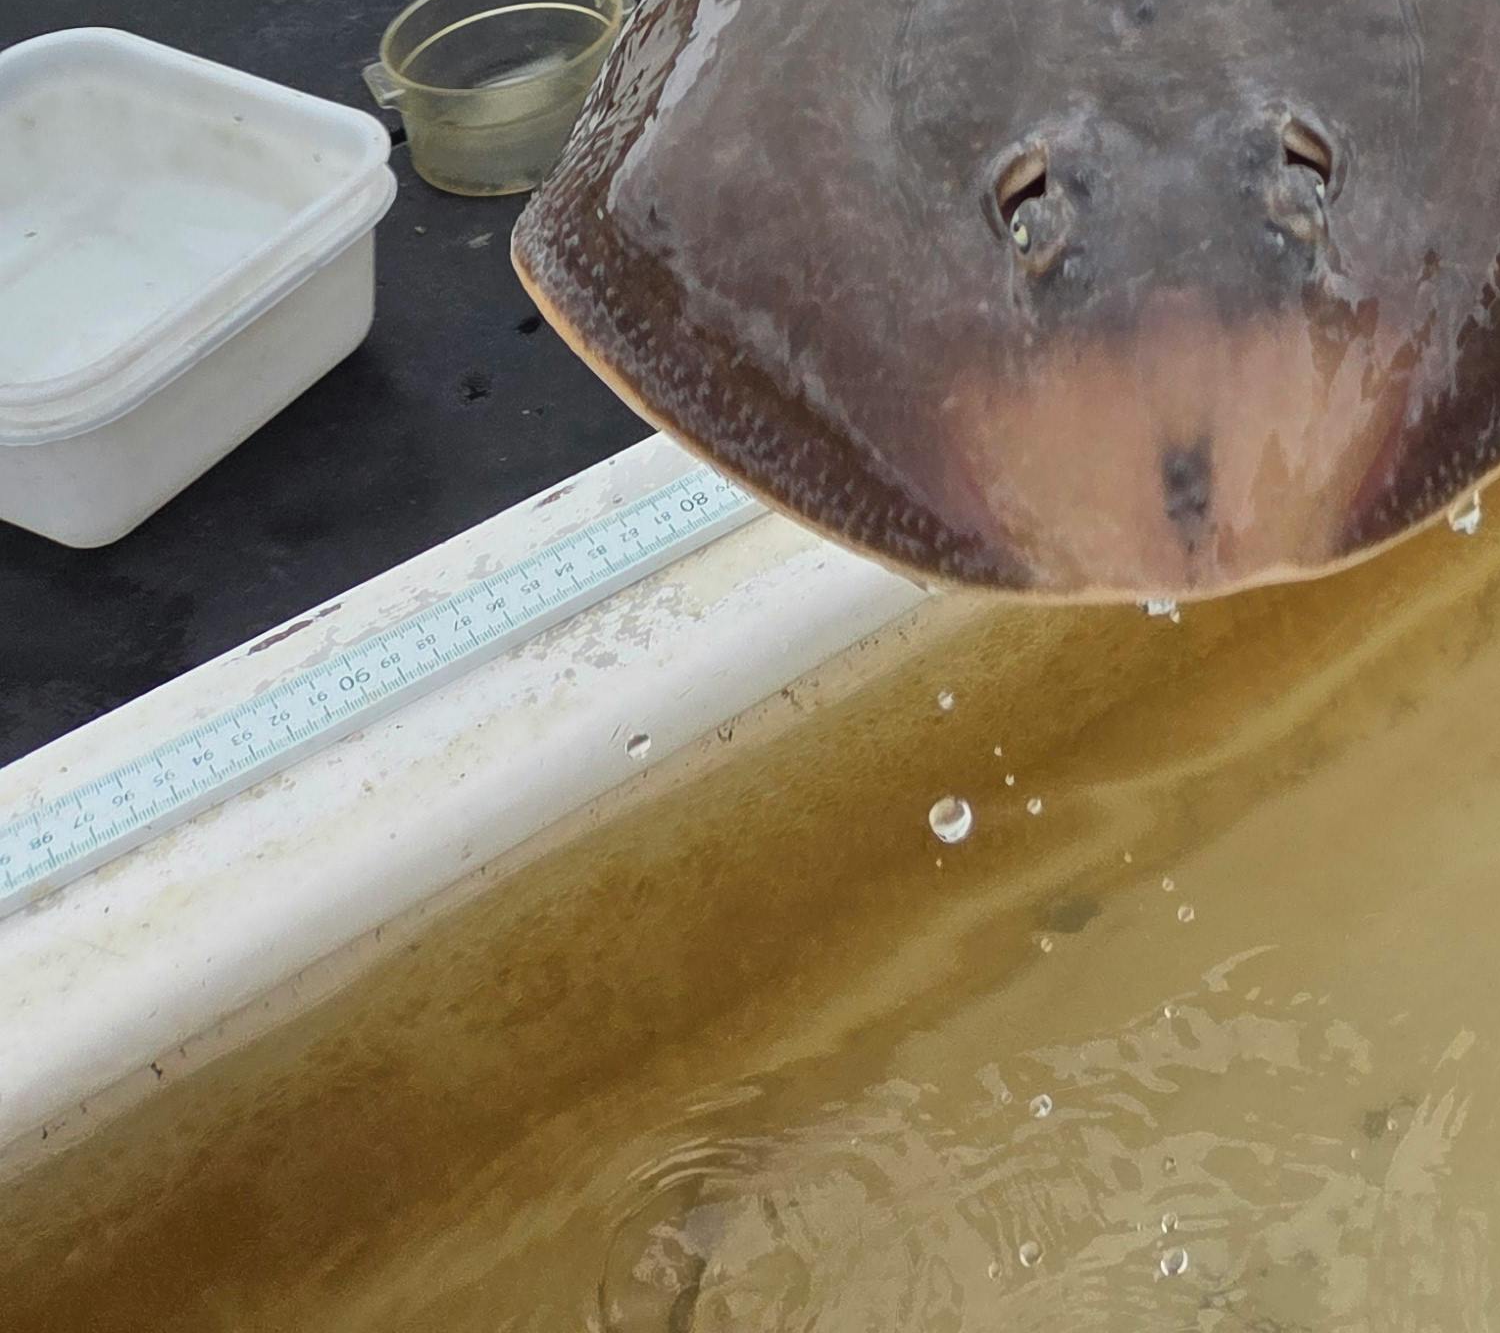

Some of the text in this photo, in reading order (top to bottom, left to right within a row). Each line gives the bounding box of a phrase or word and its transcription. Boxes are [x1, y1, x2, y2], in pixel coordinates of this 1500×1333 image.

[680, 491, 708, 512] 80
[655, 511, 671, 525] 81
[621, 528, 640, 543] 82
[588, 544, 607, 559] 83
[521, 579, 541, 595] 85
[486, 597, 506, 613] 86
[455, 615, 471, 632] 87
[381, 652, 401, 670] 89
[339, 667, 370, 692] 90
[308, 692, 329, 707] 91
[270, 709, 290, 727] 92
[231, 731, 253, 747] 93
[192, 749, 215, 767] 94
[153, 769, 176, 788] 95
[112, 789, 135, 808] 96
[73, 812, 95, 830] 97
[30, 831, 53, 851] 98
